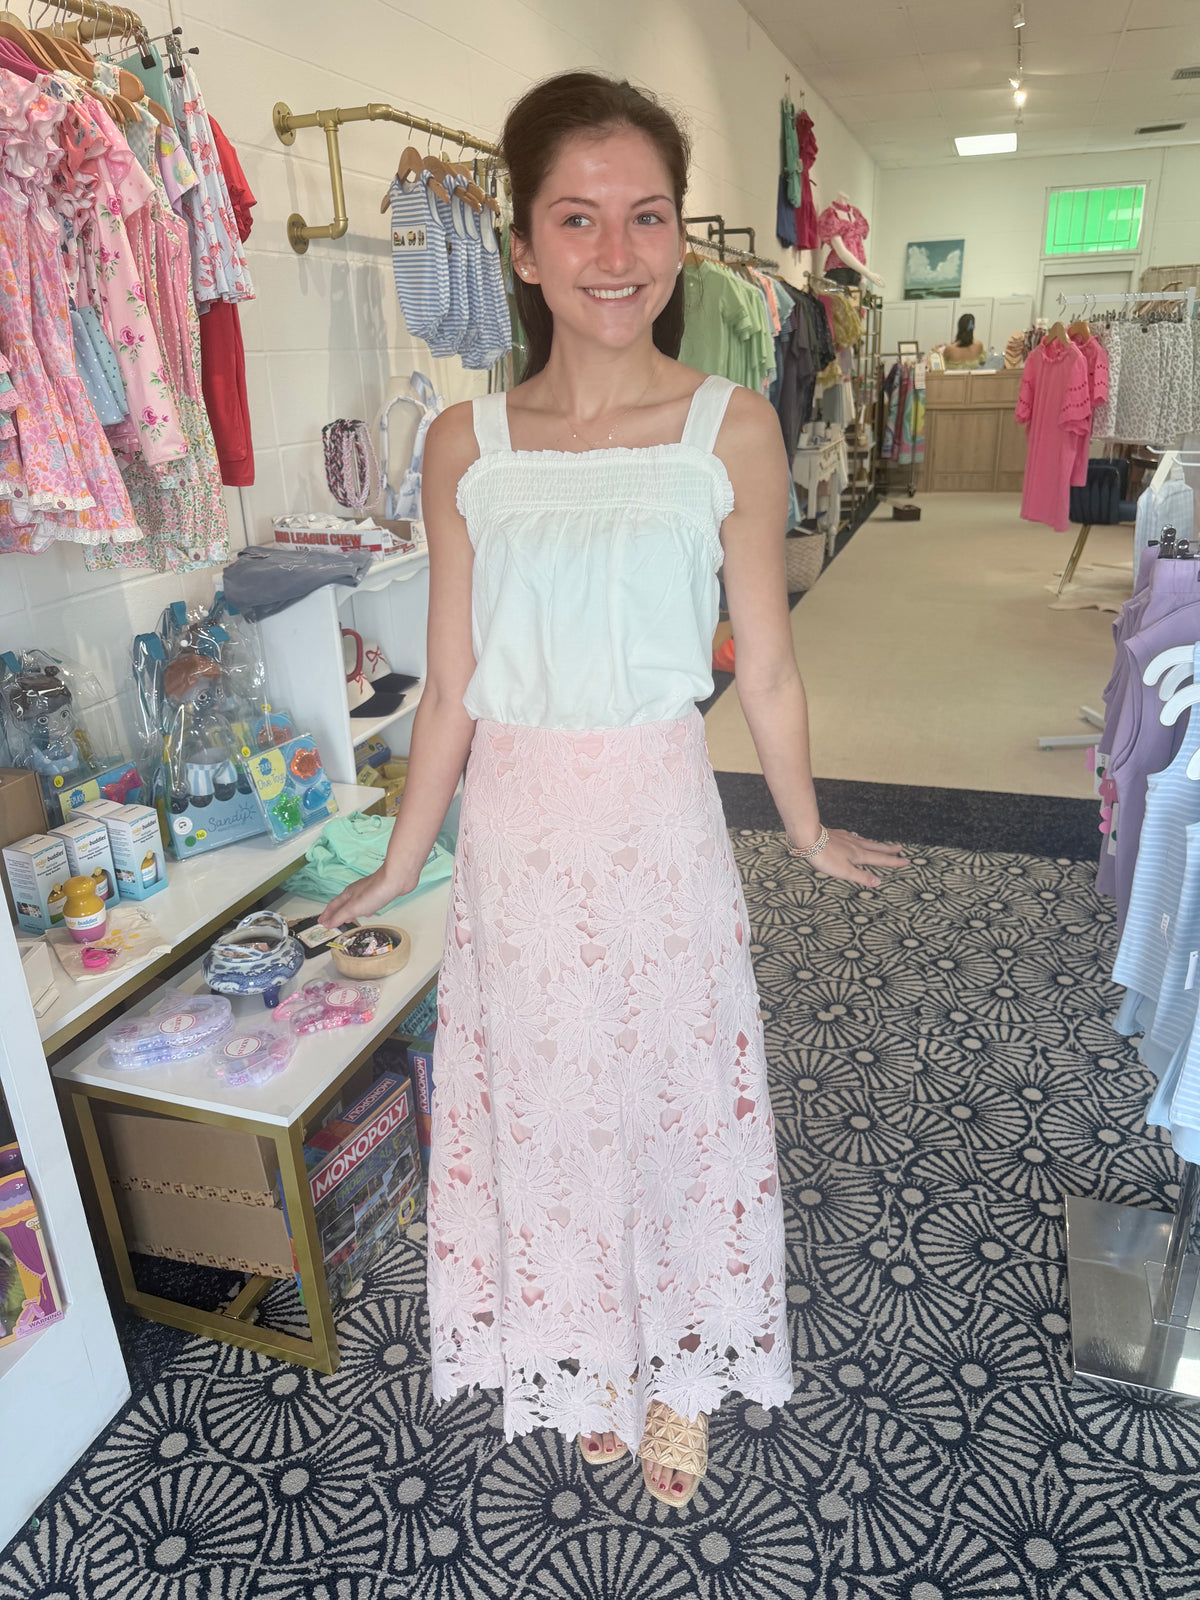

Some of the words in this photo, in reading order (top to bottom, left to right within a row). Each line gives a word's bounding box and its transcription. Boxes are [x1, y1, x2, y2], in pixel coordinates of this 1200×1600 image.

[275, 531, 290, 543] BIG
[291, 532, 329, 545] LEAGUE
[330, 534, 361, 546] CHEW
[77, 917, 98, 926] buddies
[416, 1057, 429, 1113] MONOPOLY
[348, 1080, 393, 1121] MONOPOLY
[316, 1097, 406, 1199] MONOPOLY
[28, 1310, 62, 1328] WARNING
